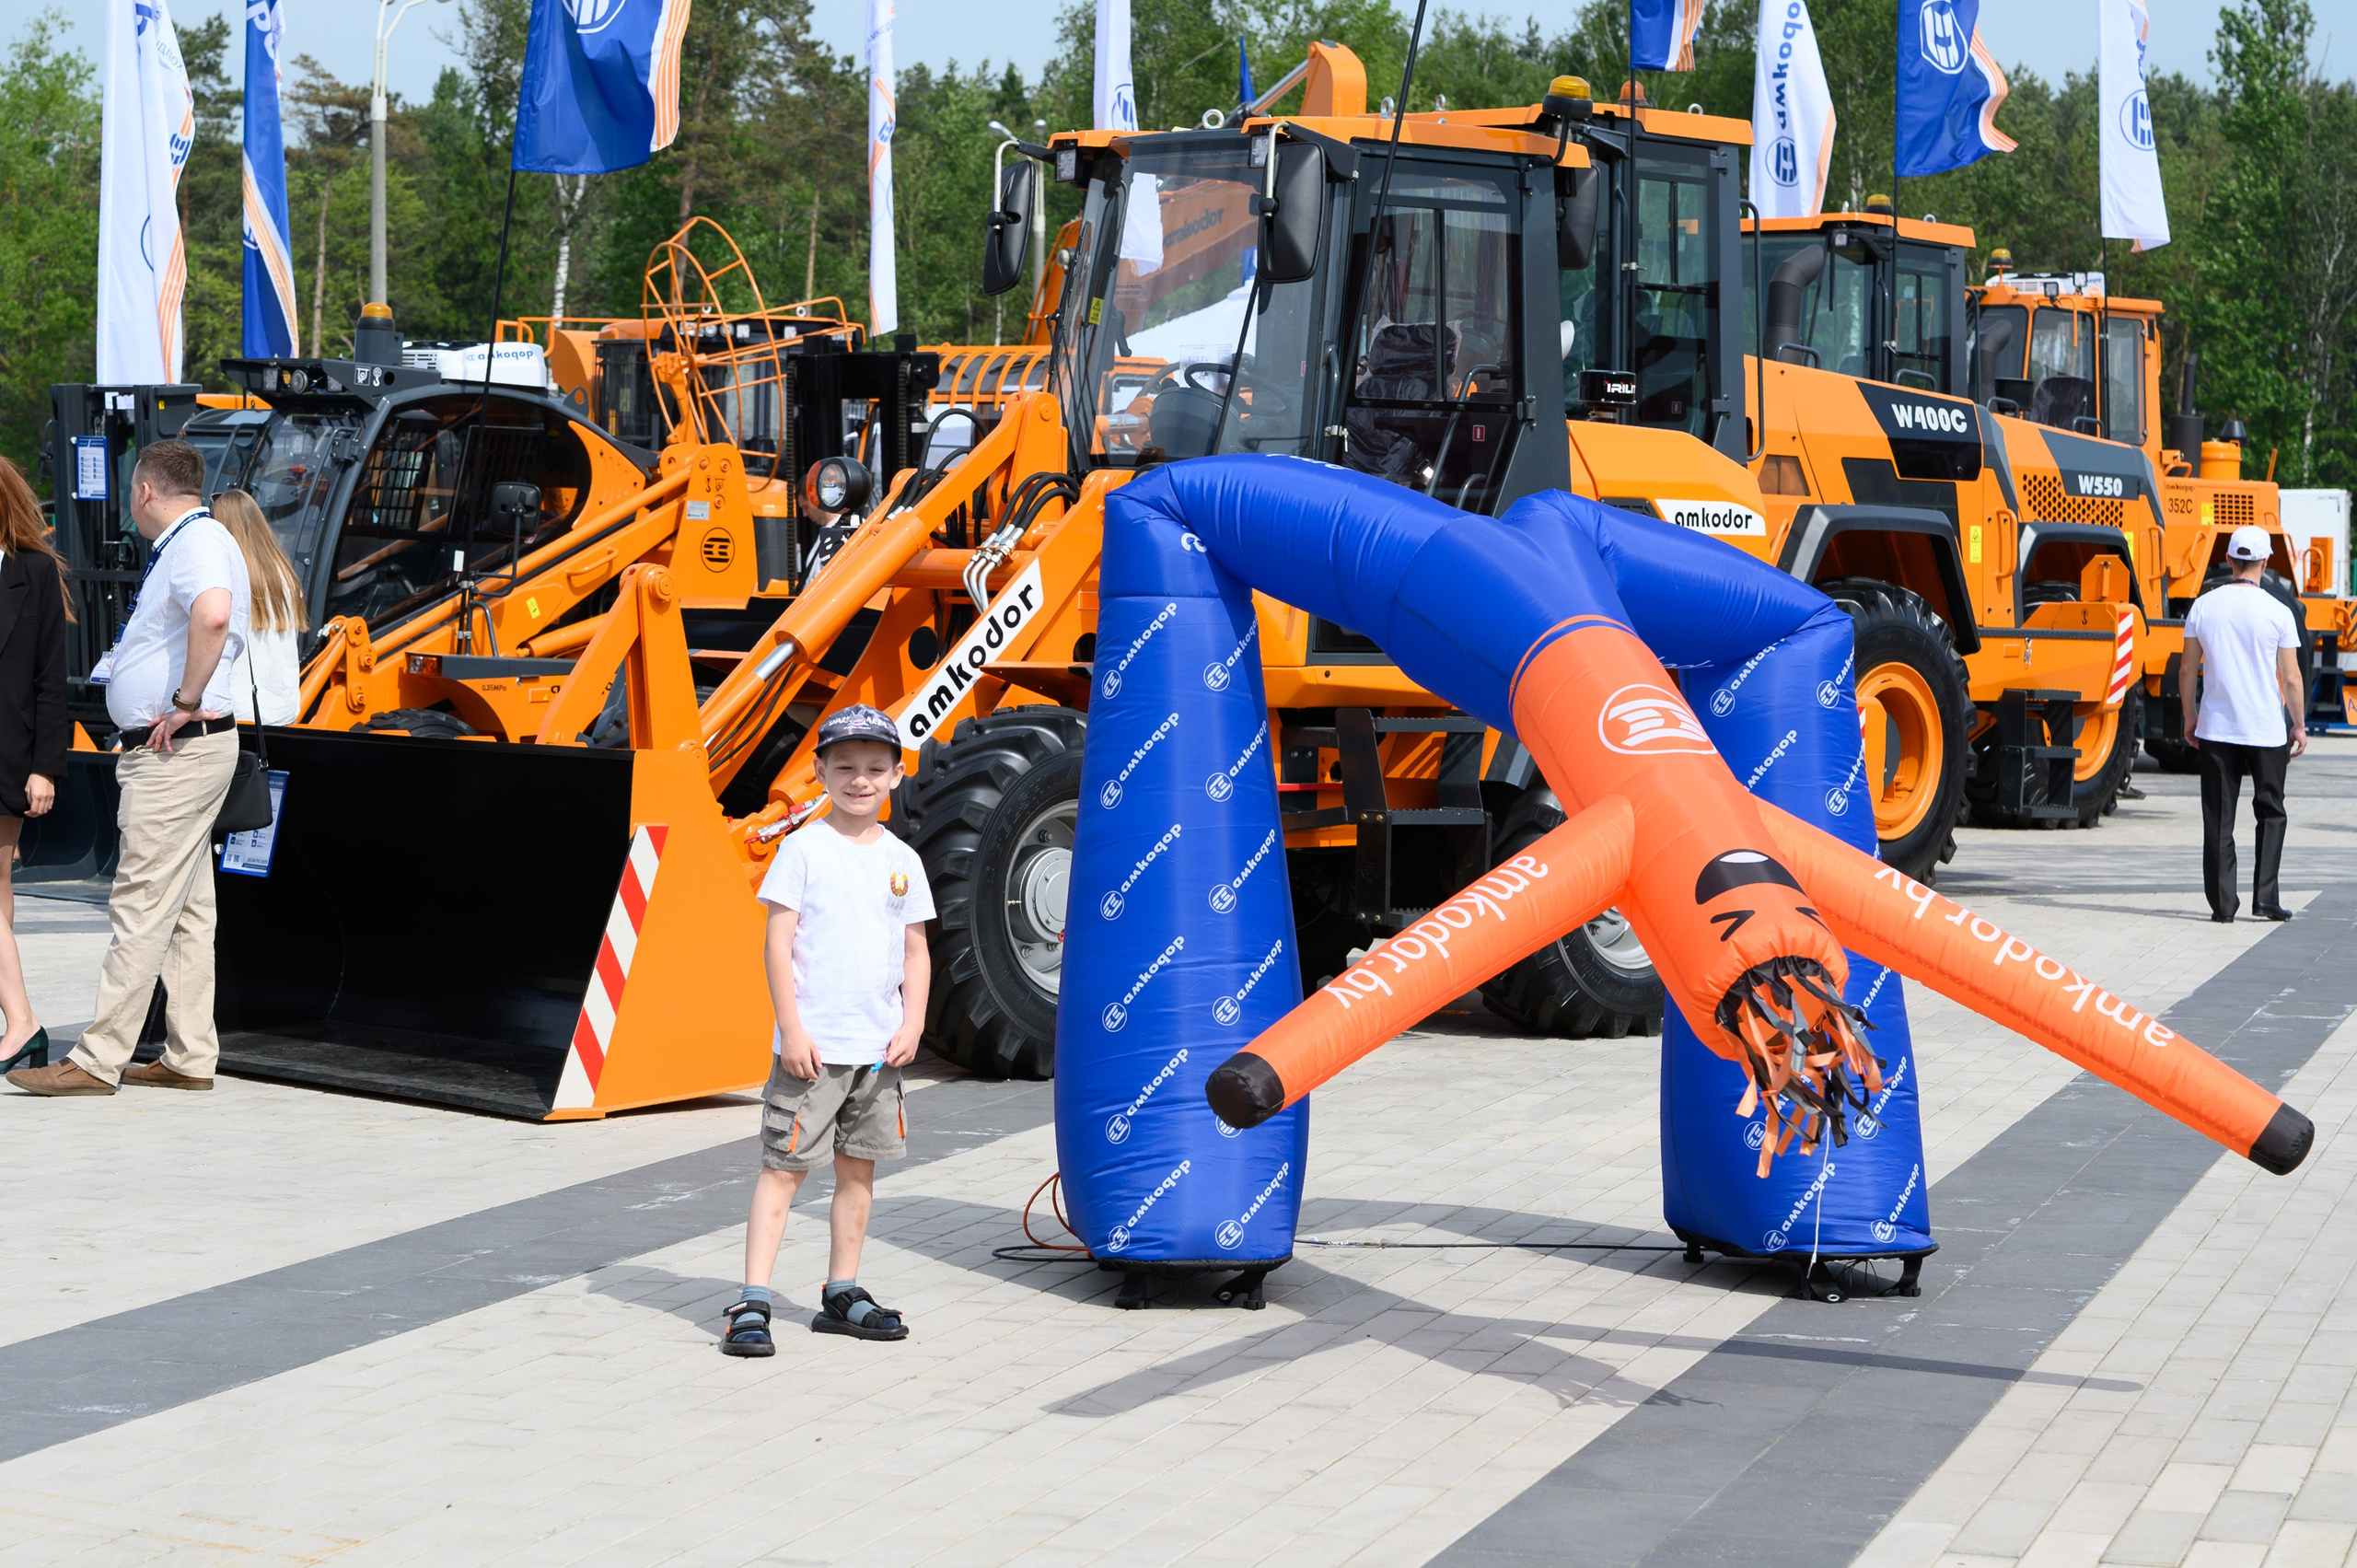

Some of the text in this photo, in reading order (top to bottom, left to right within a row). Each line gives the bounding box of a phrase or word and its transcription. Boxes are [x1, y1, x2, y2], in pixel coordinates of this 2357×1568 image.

[1891, 404, 1968, 434] W400C
[2078, 474, 2123, 497] W550
[2168, 498, 2193, 514] 352C
[1675, 507, 1753, 529] amkodor
[910, 584, 1033, 738] amkodor
[866, 716, 888, 728] AREA
[1324, 856, 1549, 1008] amkodor.by
